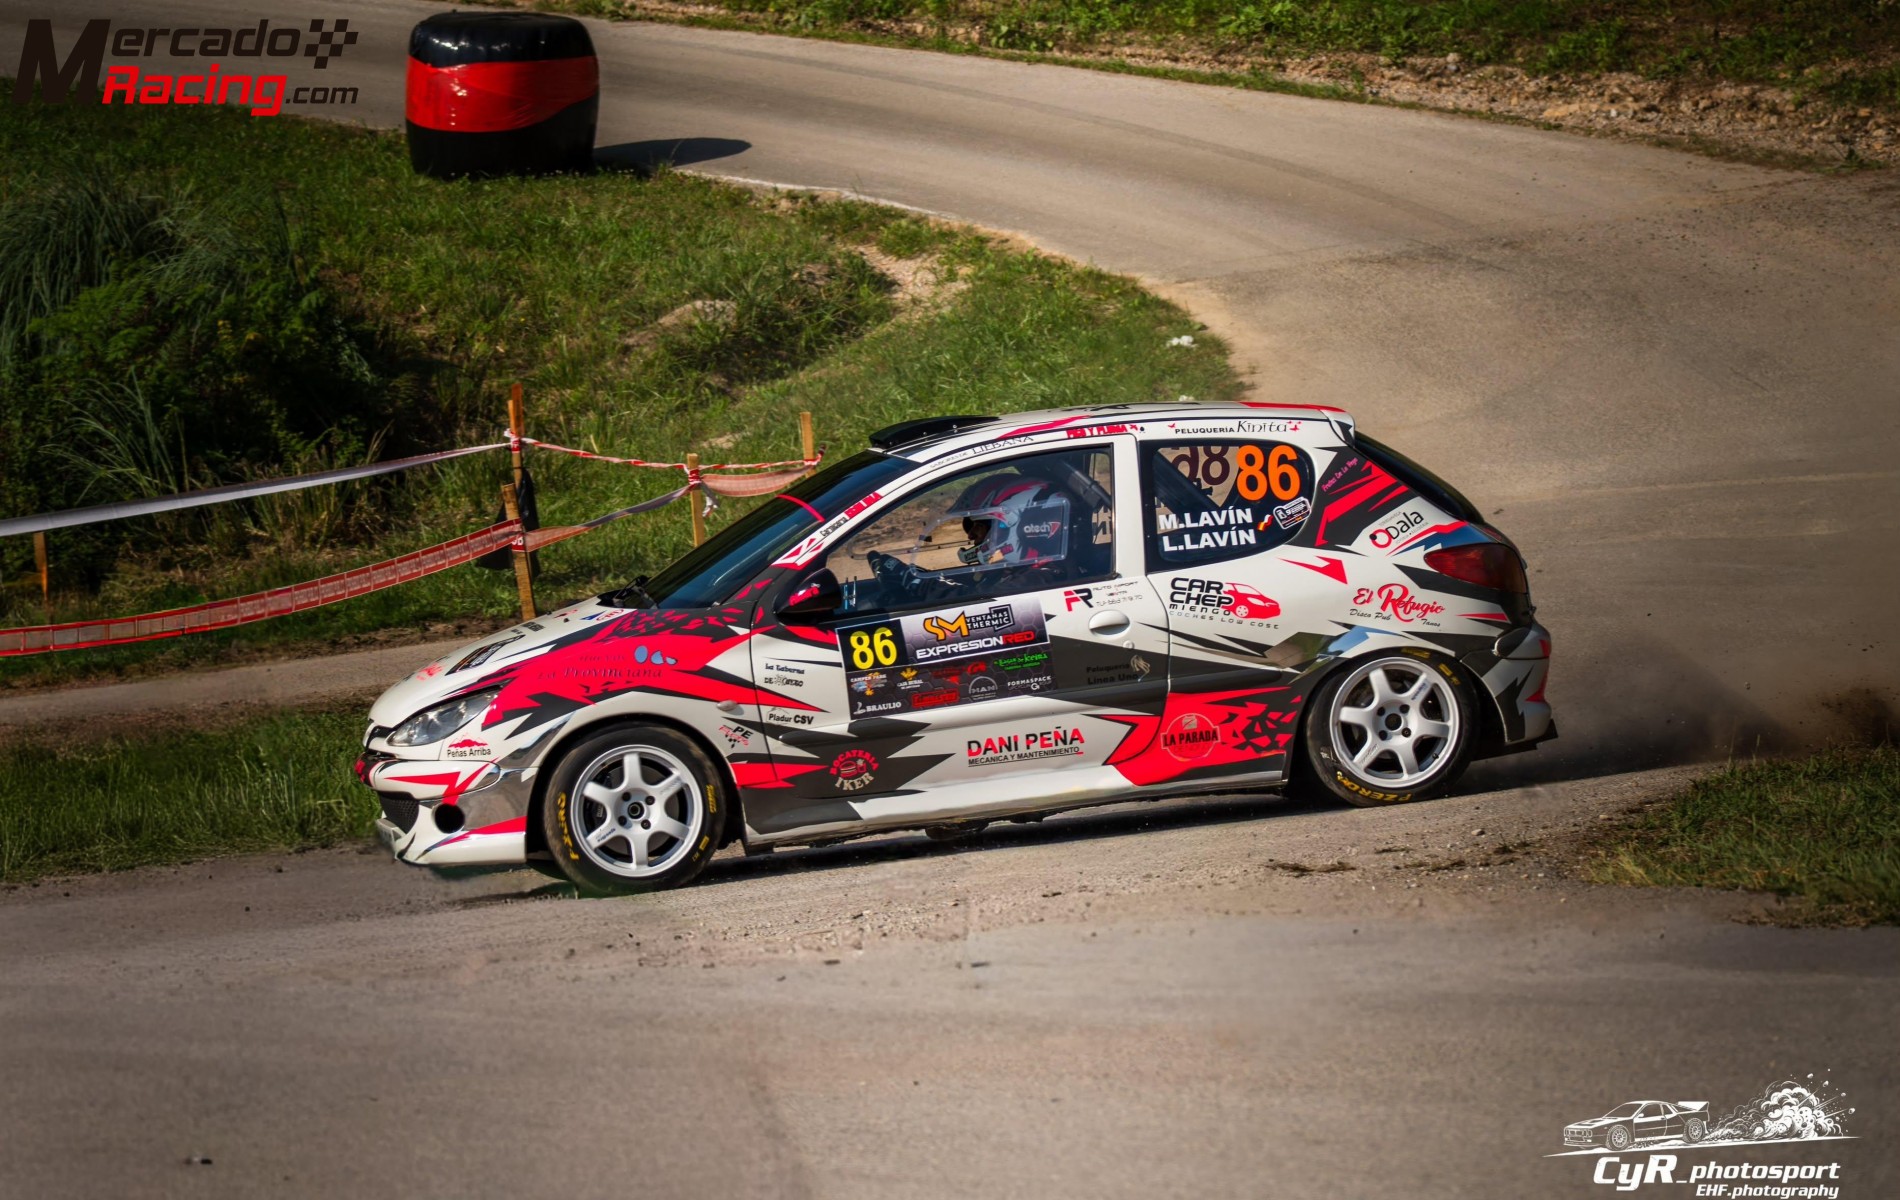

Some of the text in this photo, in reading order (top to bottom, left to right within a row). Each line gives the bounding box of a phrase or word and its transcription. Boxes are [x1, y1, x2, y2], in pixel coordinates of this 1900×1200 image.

[1175, 426, 1235, 434] PELUQUERÍA
[1236, 444, 1300, 501] 86
[1159, 506, 1253, 530] M.LAVÍN
[1162, 526, 1256, 552] L.LAVÍN
[1170, 577, 1223, 594] CAR
[1169, 591, 1233, 607] CHEP
[1352, 583, 1445, 622] El Refugio
[966, 611, 1008, 623] VENTANAS
[1169, 603, 1231, 616] MIENGO
[1169, 610, 1214, 621] COCHES
[1349, 608, 1392, 621] Disco Pub
[923, 611, 970, 641] SM
[967, 617, 1010, 630] THERMIC
[850, 627, 897, 670] 86
[1007, 675, 1052, 687] FORMASPACK
[865, 702, 902, 712] BRAULIO
[769, 713, 814, 725] Pladur CSV
[967, 726, 1085, 757] DANI PEÑA
[1163, 730, 1218, 747] LA PARADA
[447, 747, 491, 758] Peñas Arriba
[968, 754, 1008, 765] MECANICA
[1017, 746, 1080, 760] MANTENIMIENTO
[835, 772, 874, 790] IKER
